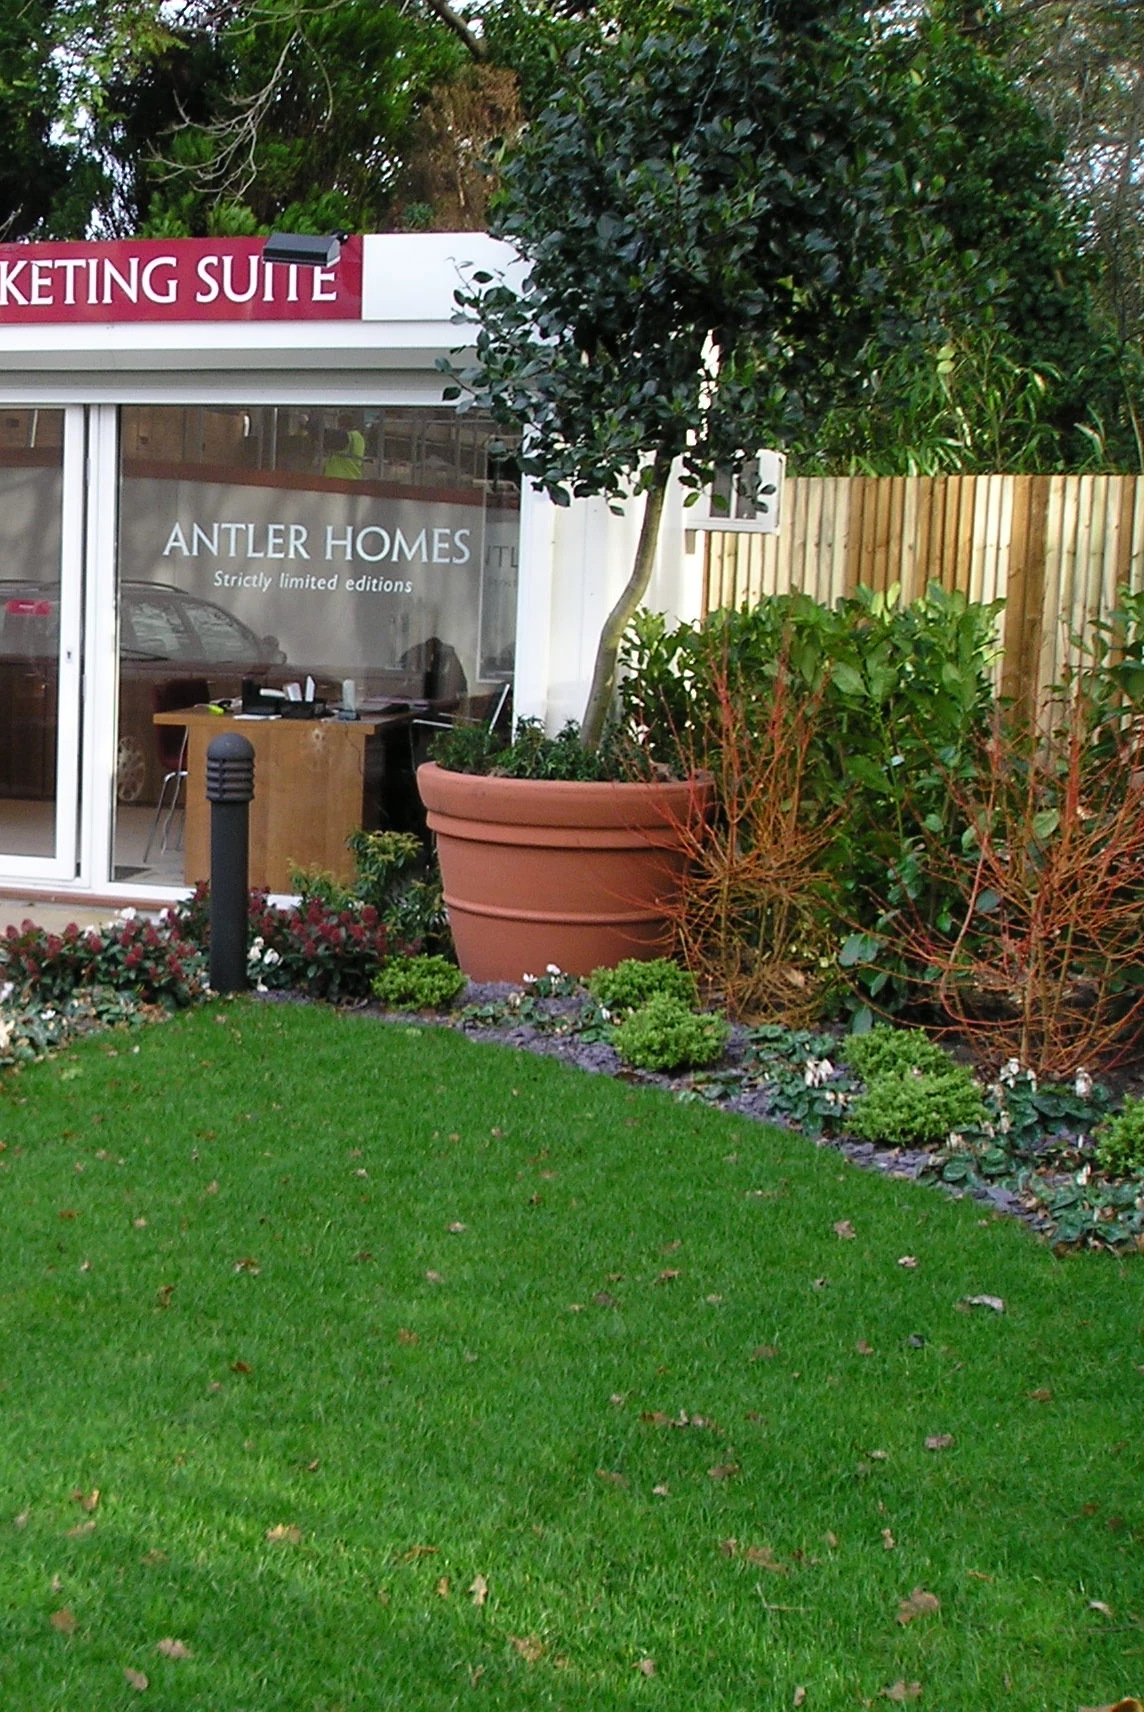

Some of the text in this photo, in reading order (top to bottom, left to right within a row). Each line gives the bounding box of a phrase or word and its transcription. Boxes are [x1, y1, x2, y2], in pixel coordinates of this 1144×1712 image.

[162, 522, 310, 559] ANTLER
[325, 525, 471, 564] HOMES
[213, 570, 413, 593] Strictly limited editions
